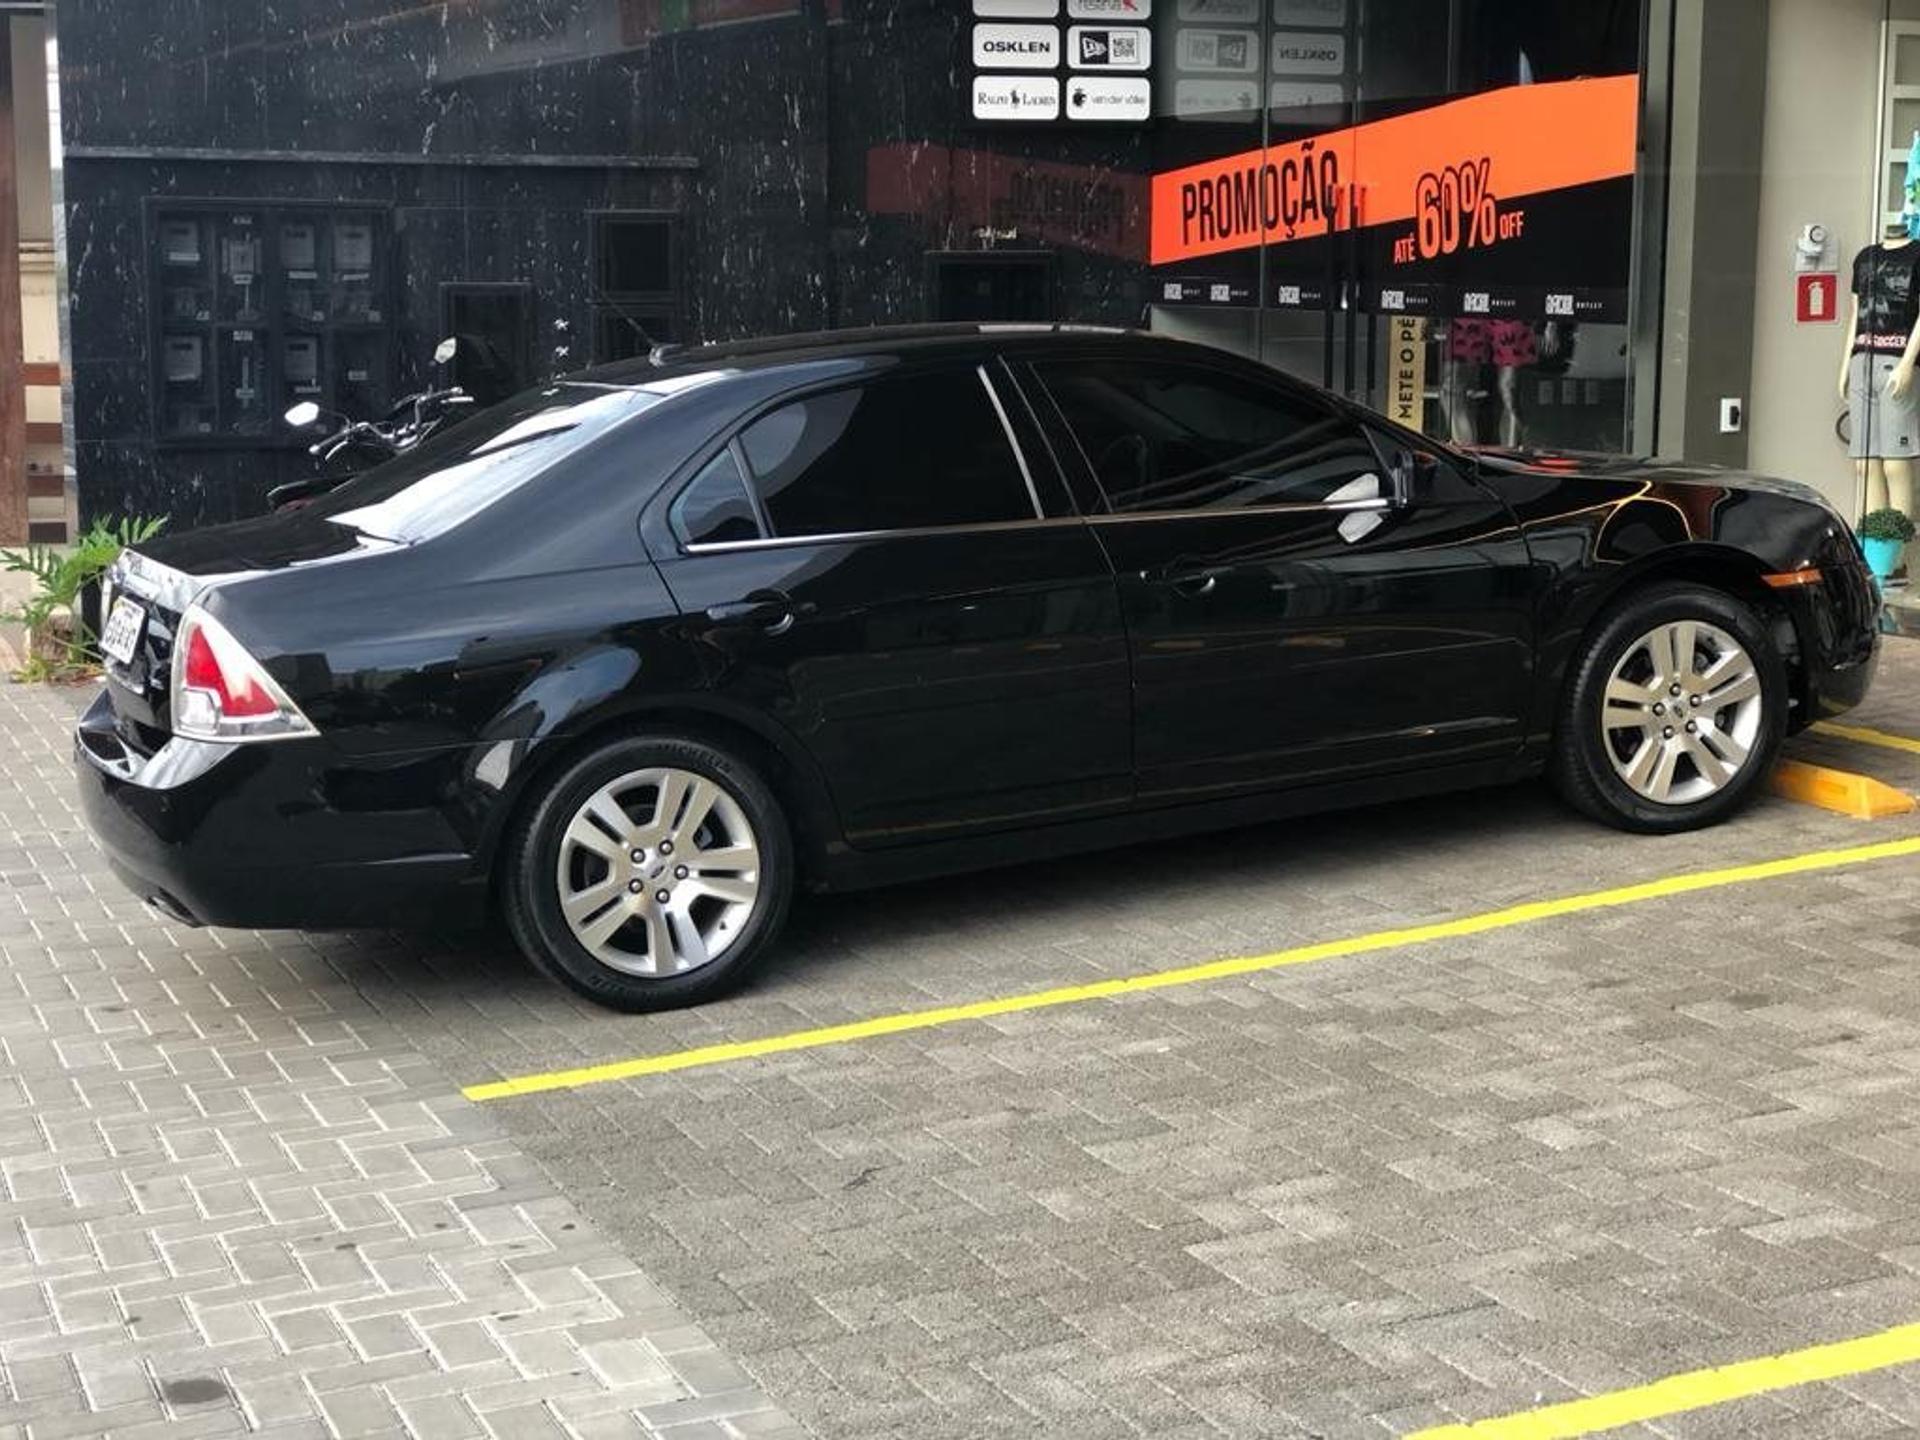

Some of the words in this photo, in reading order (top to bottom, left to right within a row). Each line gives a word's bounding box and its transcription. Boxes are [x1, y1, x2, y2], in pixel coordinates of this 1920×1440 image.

[983, 41, 1050, 53] OSKLEN
[1182, 141, 1338, 246] PROMOÇÃO
[1394, 232, 1416, 264] ATÉ
[1416, 157, 1496, 259] 60%
[1500, 211, 1524, 239] OFF
[1400, 348, 1415, 364] O
[1398, 368, 1414, 418] METE
